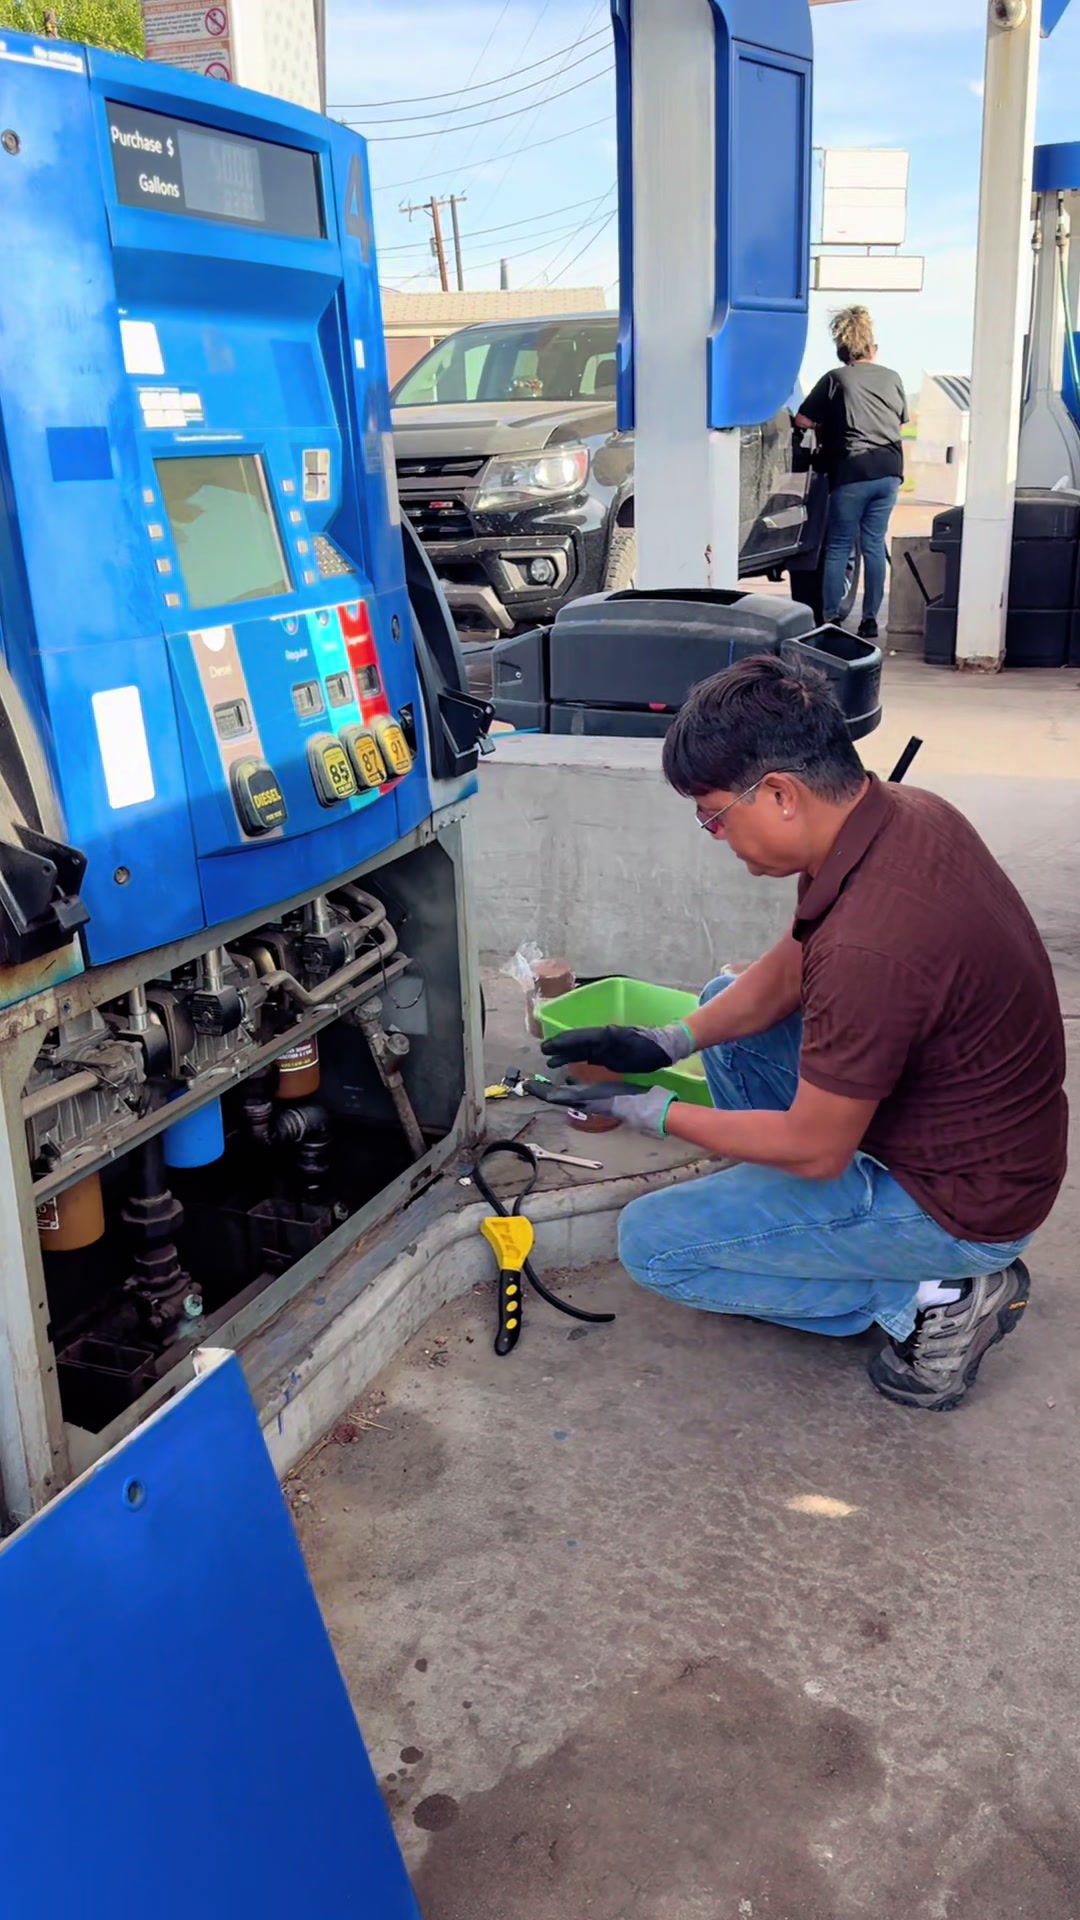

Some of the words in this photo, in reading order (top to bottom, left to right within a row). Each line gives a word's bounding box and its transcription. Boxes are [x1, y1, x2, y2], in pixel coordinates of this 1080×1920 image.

[110, 125, 163, 154] Purchase
[166, 136, 175, 158] $
[139, 173, 180, 198] Gallons
[344, 153, 371, 266] 4
[362, 749, 381, 773] 87
[391, 740, 406, 762] 91
[329, 760, 350, 785] 85
[253, 788, 282, 809] DIESEL
